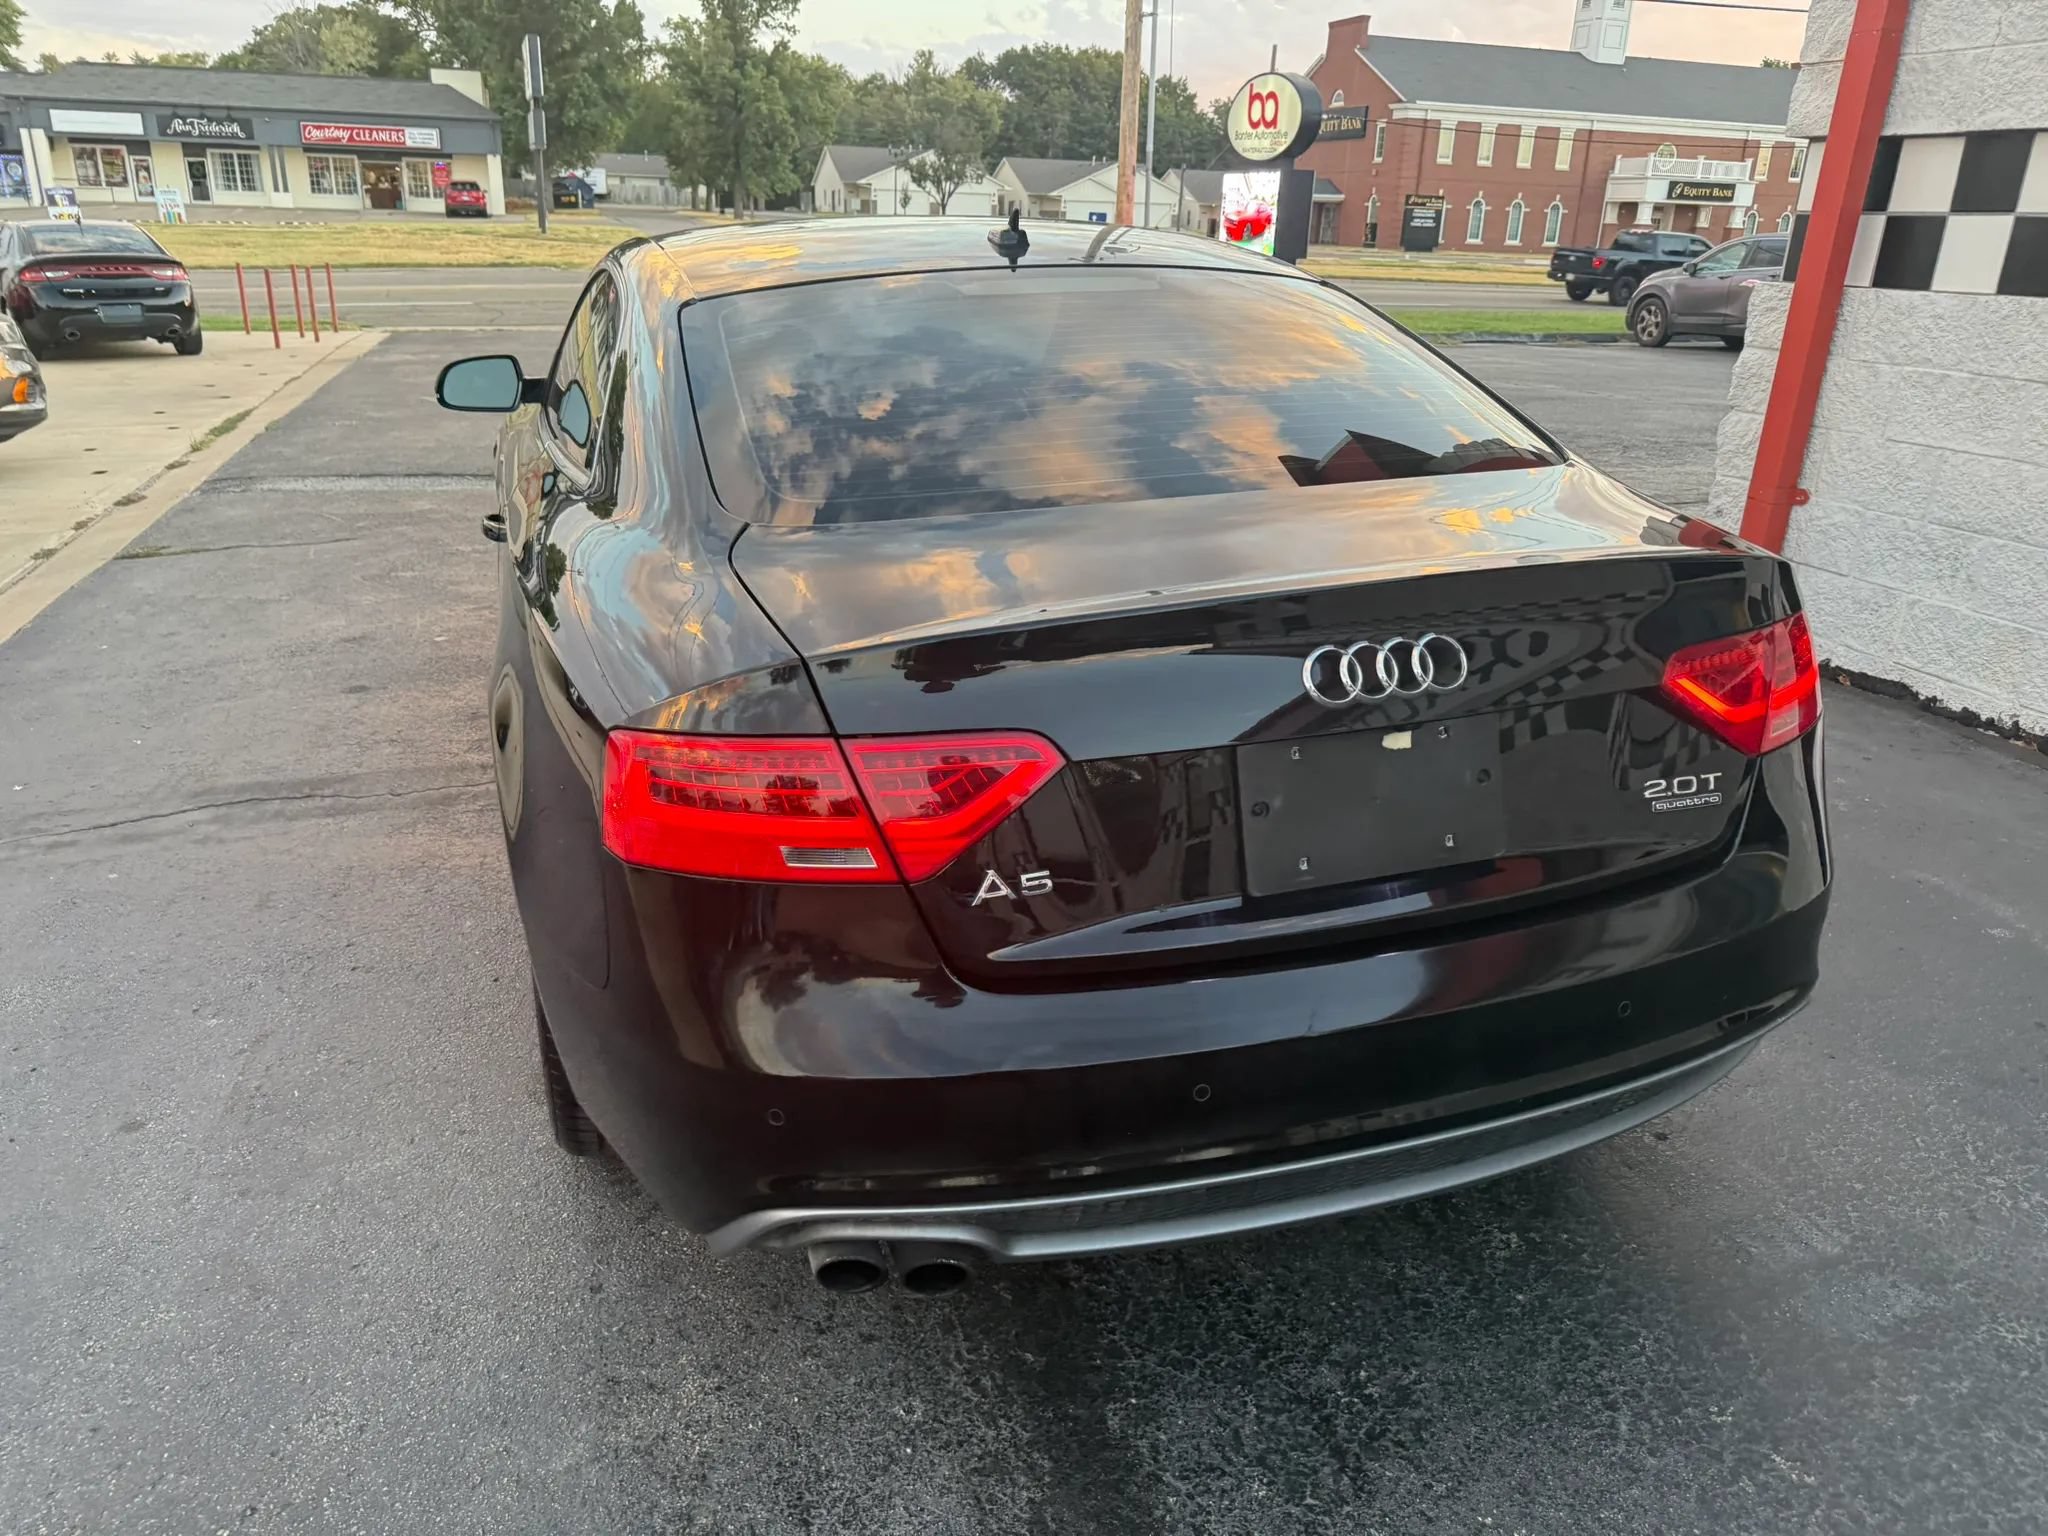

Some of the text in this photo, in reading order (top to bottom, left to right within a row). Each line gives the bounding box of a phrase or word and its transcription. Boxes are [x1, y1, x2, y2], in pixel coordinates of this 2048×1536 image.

[304, 125, 352, 144] Courtesy
[352, 129, 405, 143] CLEANERS
[1683, 186, 1733, 198] EQUITY BANK
[1643, 772, 1722, 798] 2.0T
[1655, 796, 1719, 810] quattro
[971, 869, 1053, 907] A5
